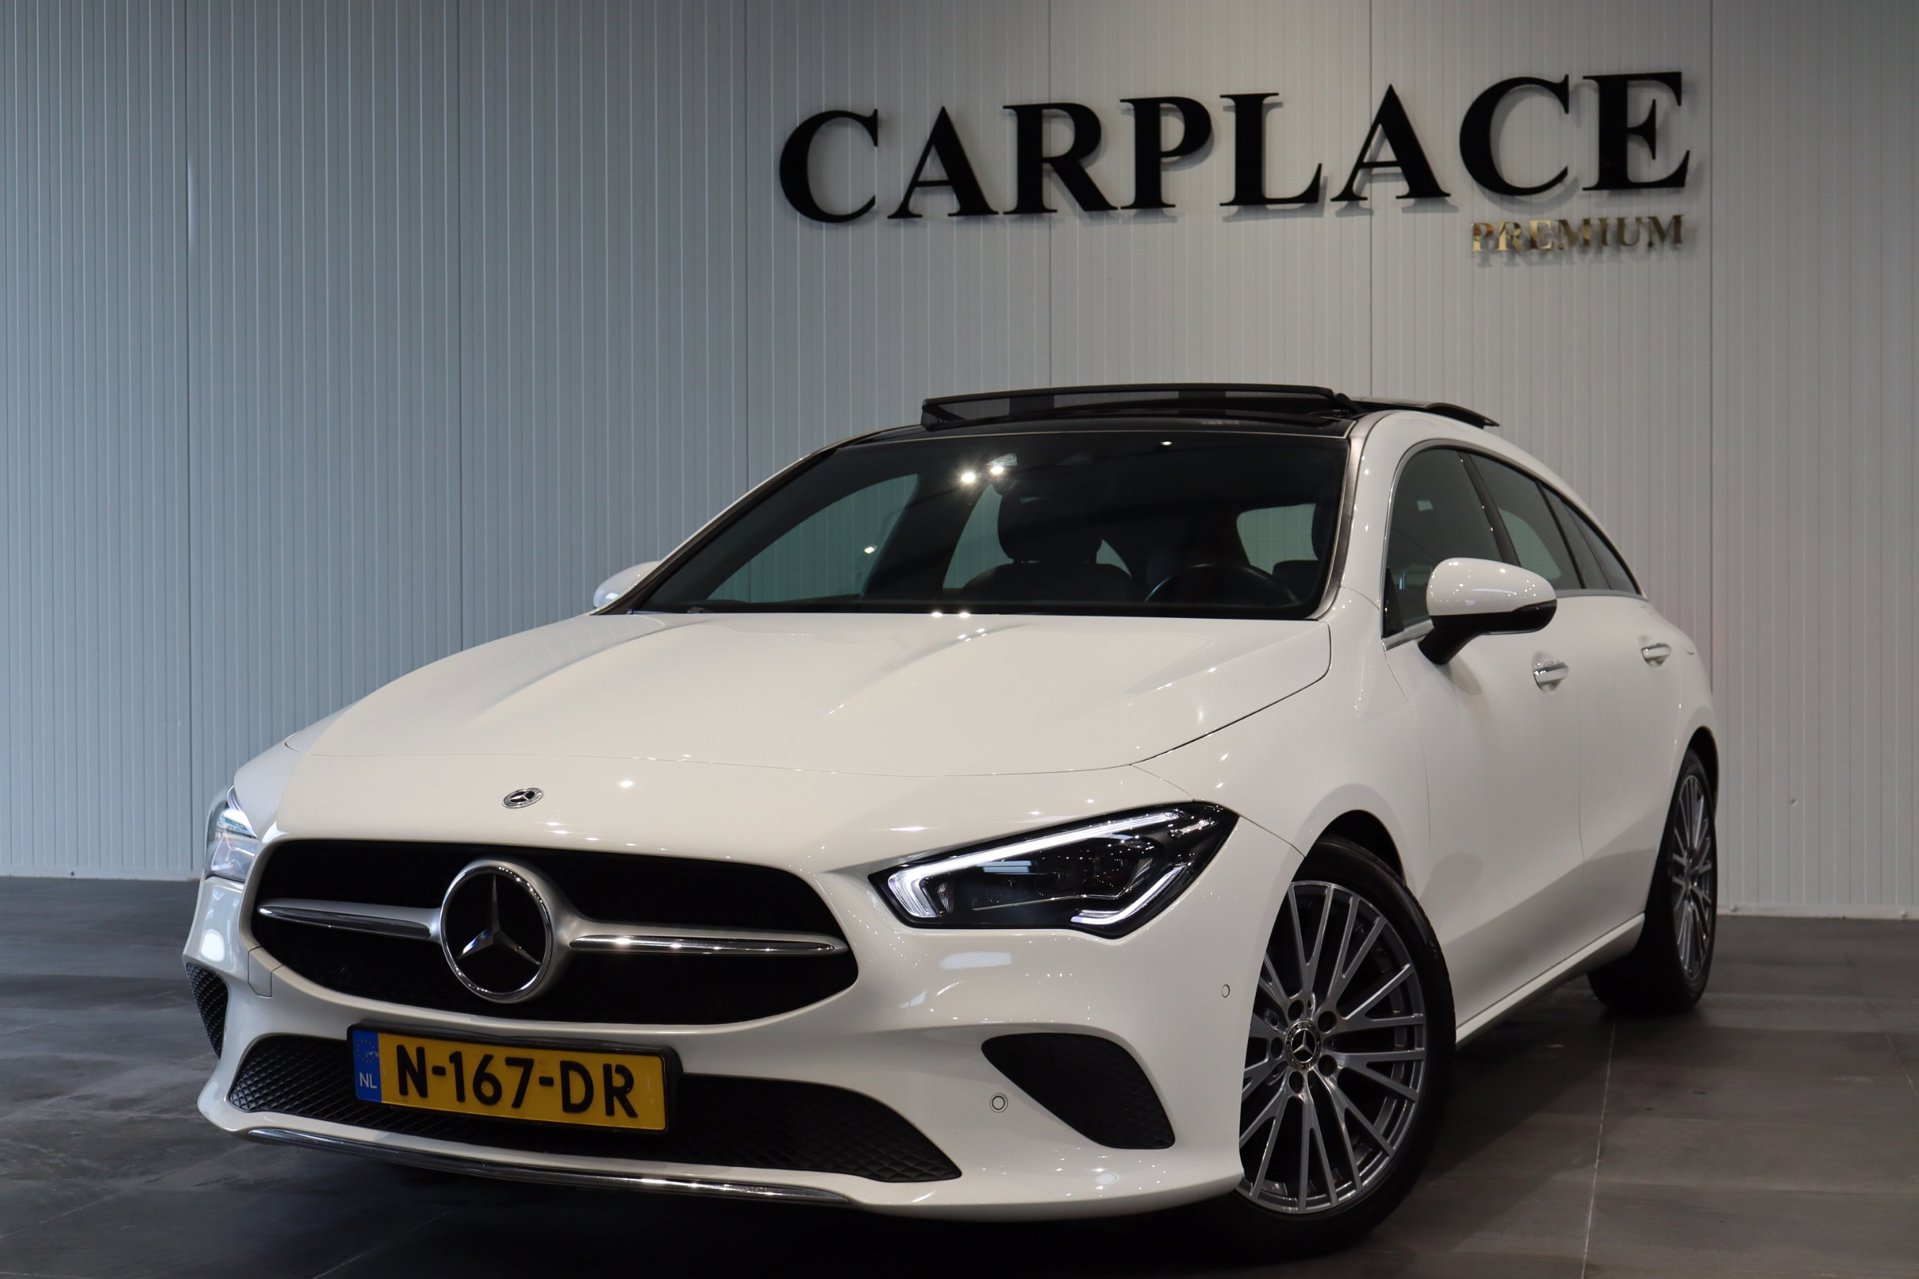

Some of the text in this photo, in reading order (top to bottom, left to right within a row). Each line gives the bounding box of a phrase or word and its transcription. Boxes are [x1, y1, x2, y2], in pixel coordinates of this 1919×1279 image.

[779, 71, 1690, 224] CARPLACE
[1472, 214, 1685, 252] PREMIUM
[359, 1072, 377, 1089] NL
[396, 1044, 637, 1118] N-167-DR
